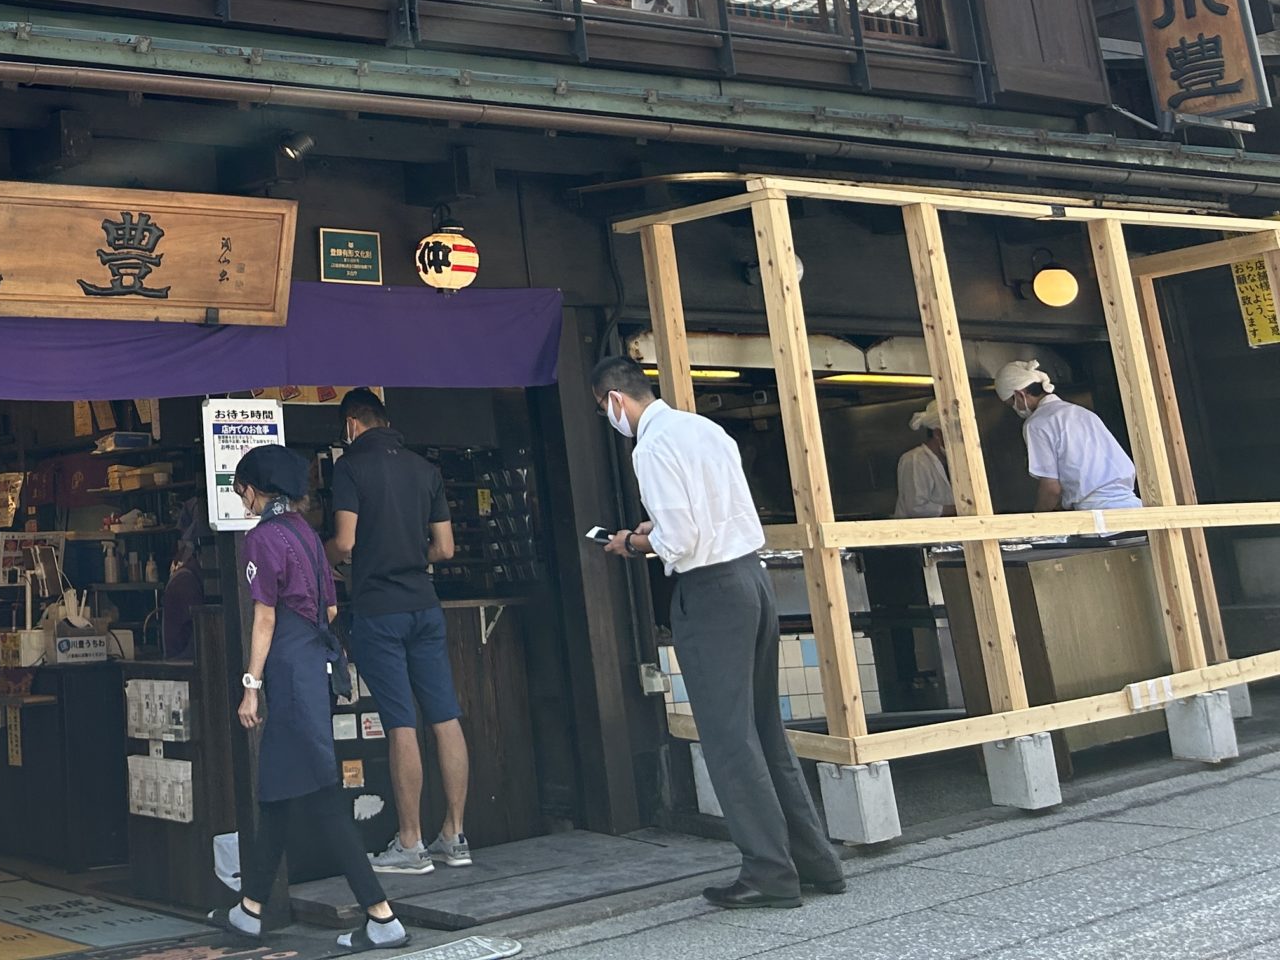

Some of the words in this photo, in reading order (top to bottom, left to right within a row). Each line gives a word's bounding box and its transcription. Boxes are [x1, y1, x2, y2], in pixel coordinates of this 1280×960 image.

[418, 241, 452, 275] 仲
[215, 409, 274, 420] お待ち時間
[221, 425, 270, 434] 店内でのお食事
